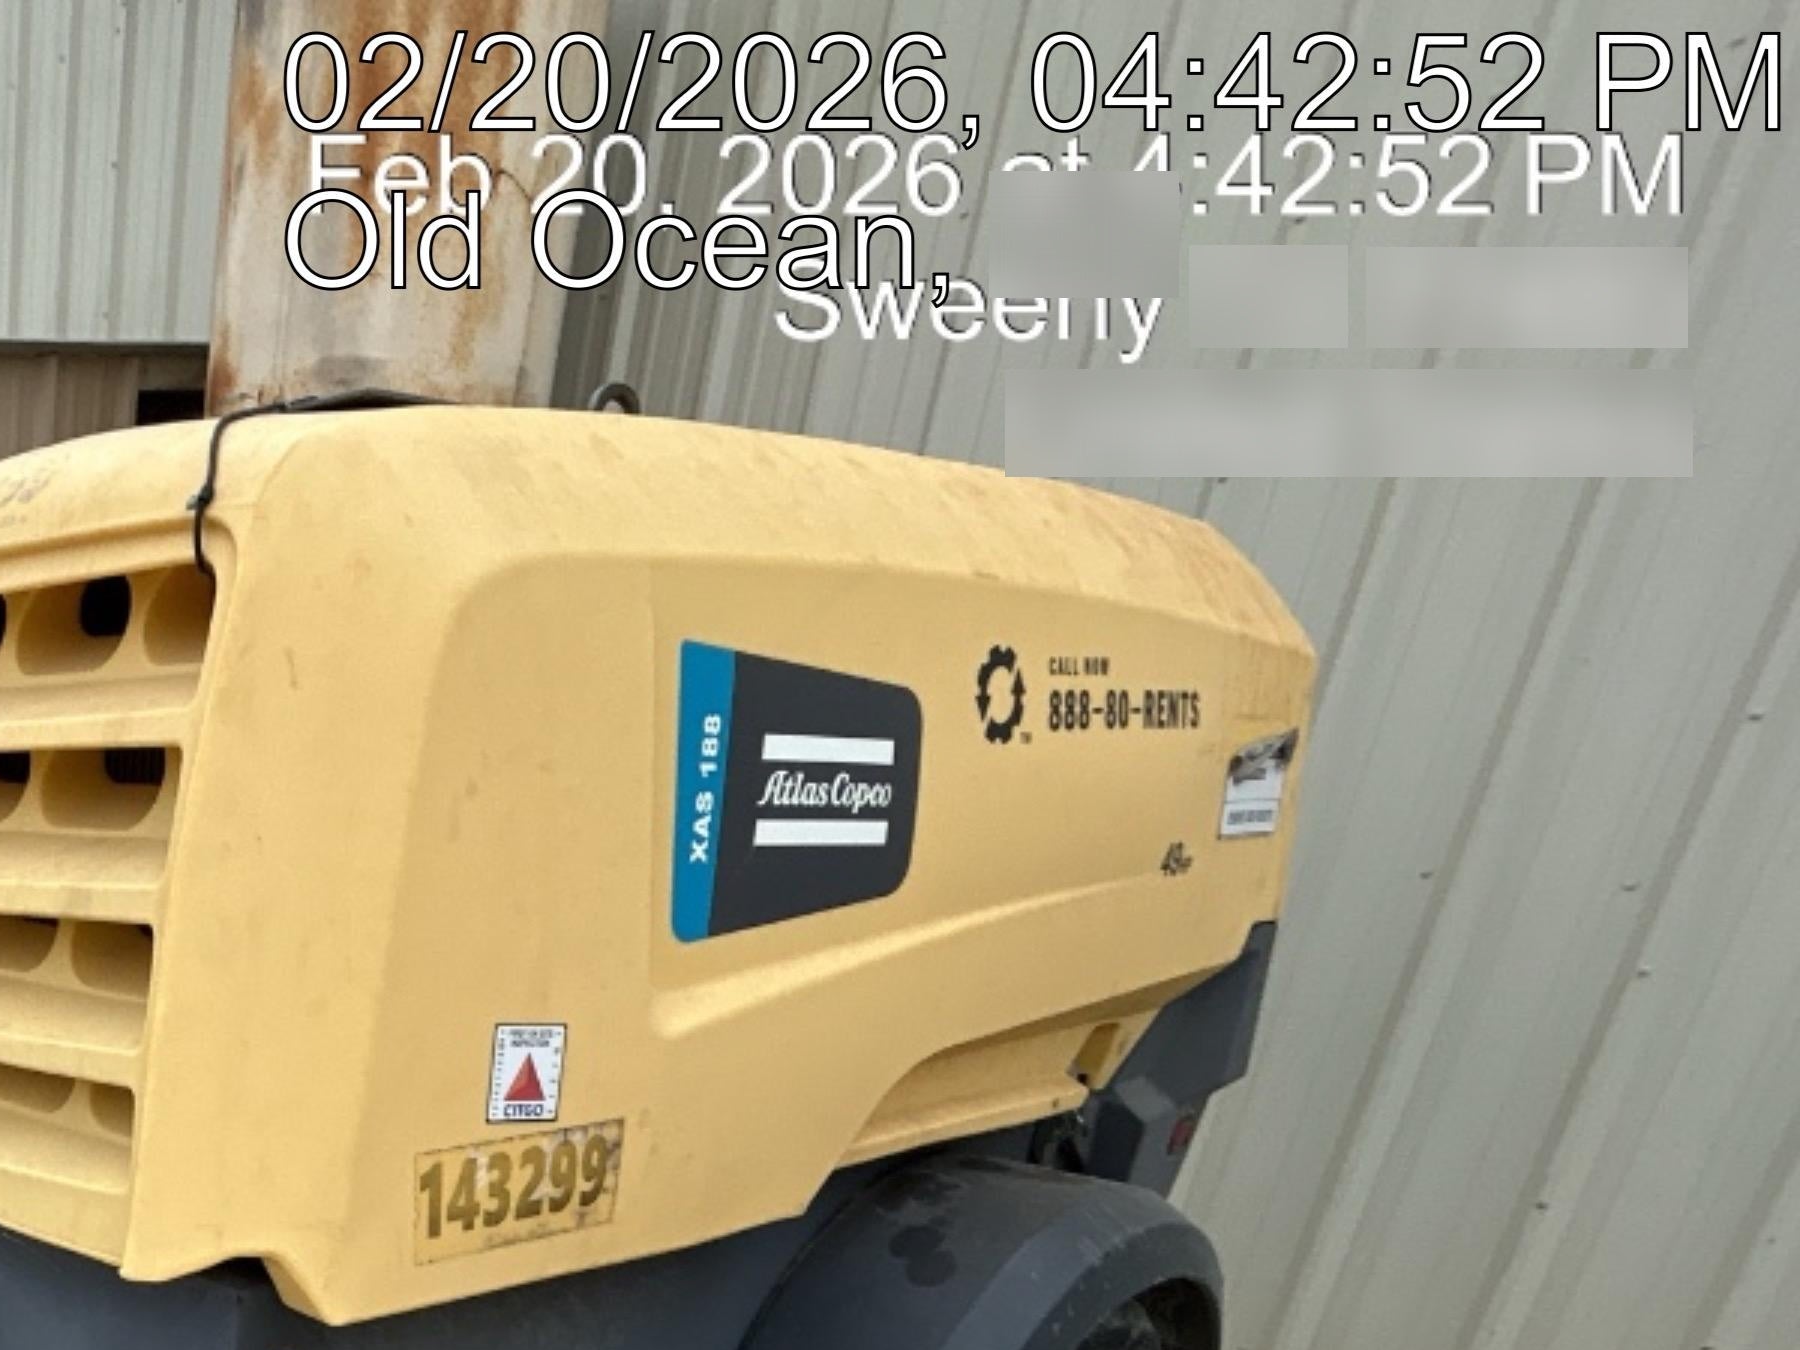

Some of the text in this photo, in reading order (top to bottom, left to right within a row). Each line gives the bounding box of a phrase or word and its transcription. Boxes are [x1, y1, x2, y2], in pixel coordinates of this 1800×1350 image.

[1049, 656, 1079, 676] CALL
[1049, 688, 1200, 732] 888-80-RENTS
[690, 713, 721, 863] XAS 188
[756, 769, 893, 814] Atlas Copco
[503, 1103, 544, 1117] CITGO
[419, 1133, 608, 1239] 143299
